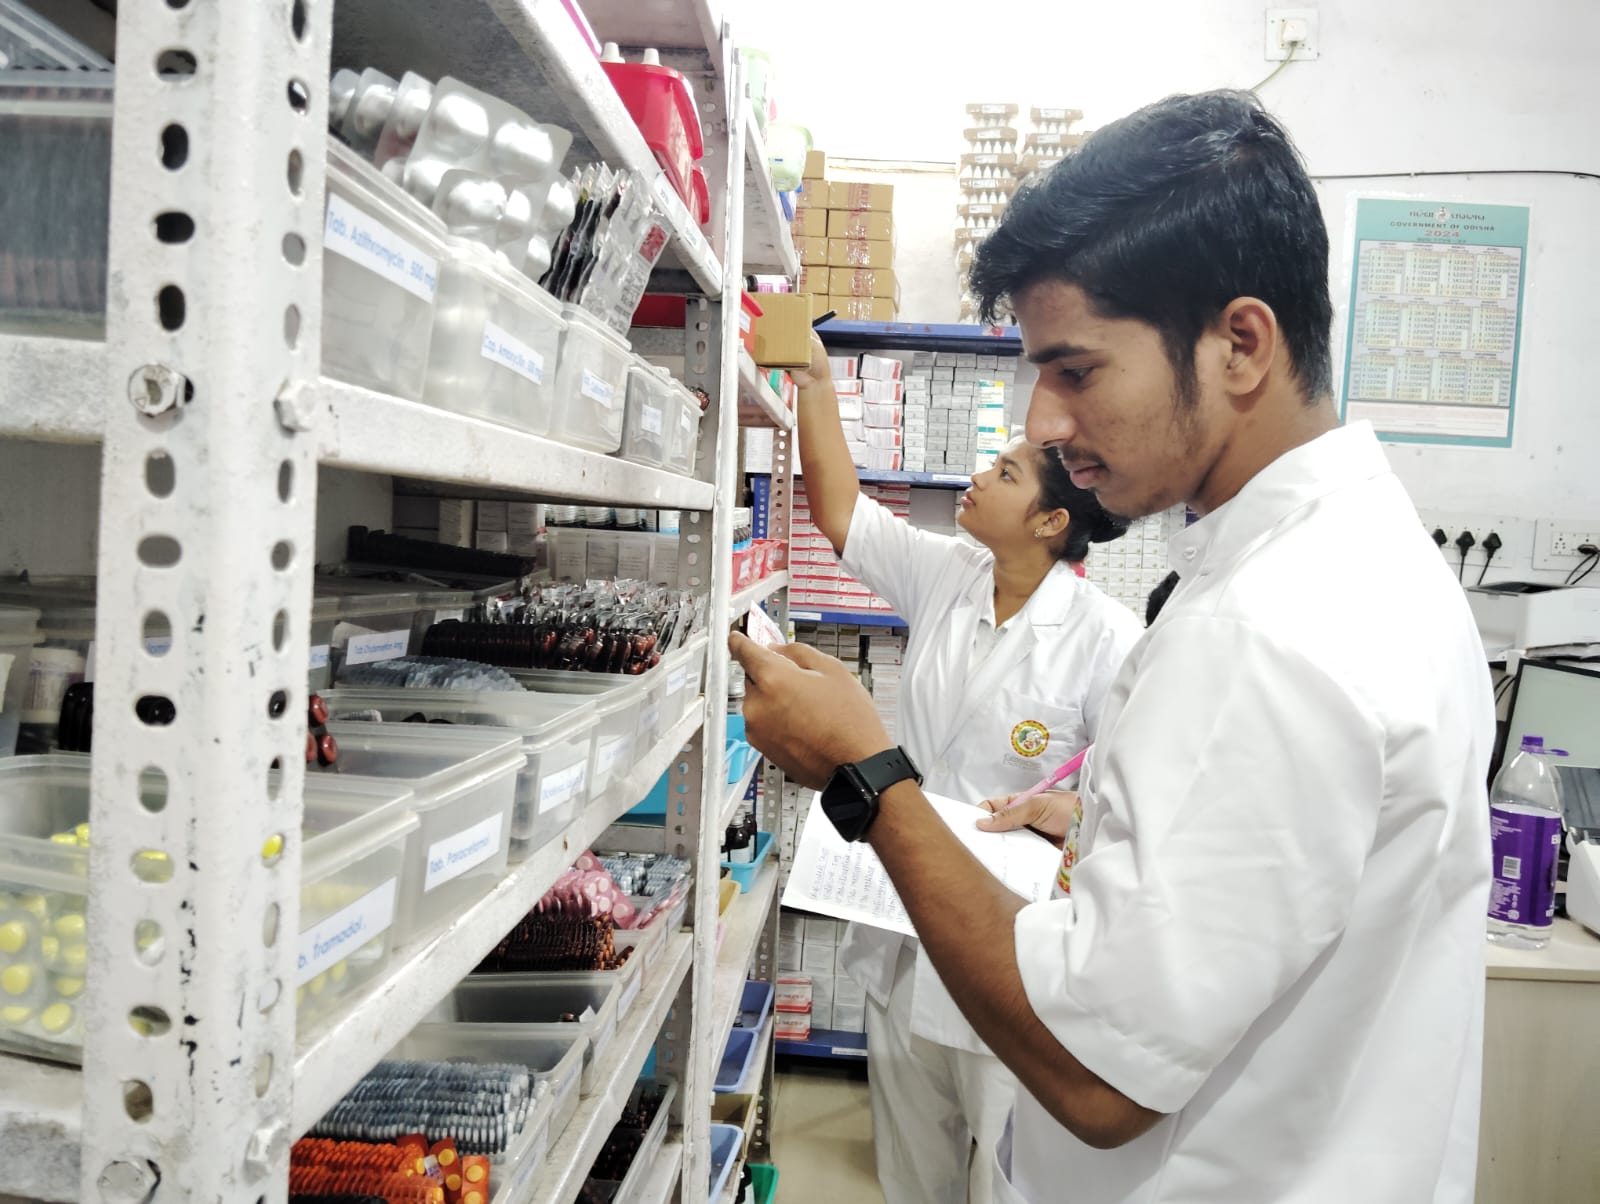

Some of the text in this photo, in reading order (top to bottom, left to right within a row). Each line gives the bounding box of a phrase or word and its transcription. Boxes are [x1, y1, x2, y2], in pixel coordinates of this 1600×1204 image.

[1390, 220, 1447, 230] GOVERNMENT
[1463, 224, 1495, 232] ODISHA
[1425, 229, 1460, 238] 2024
